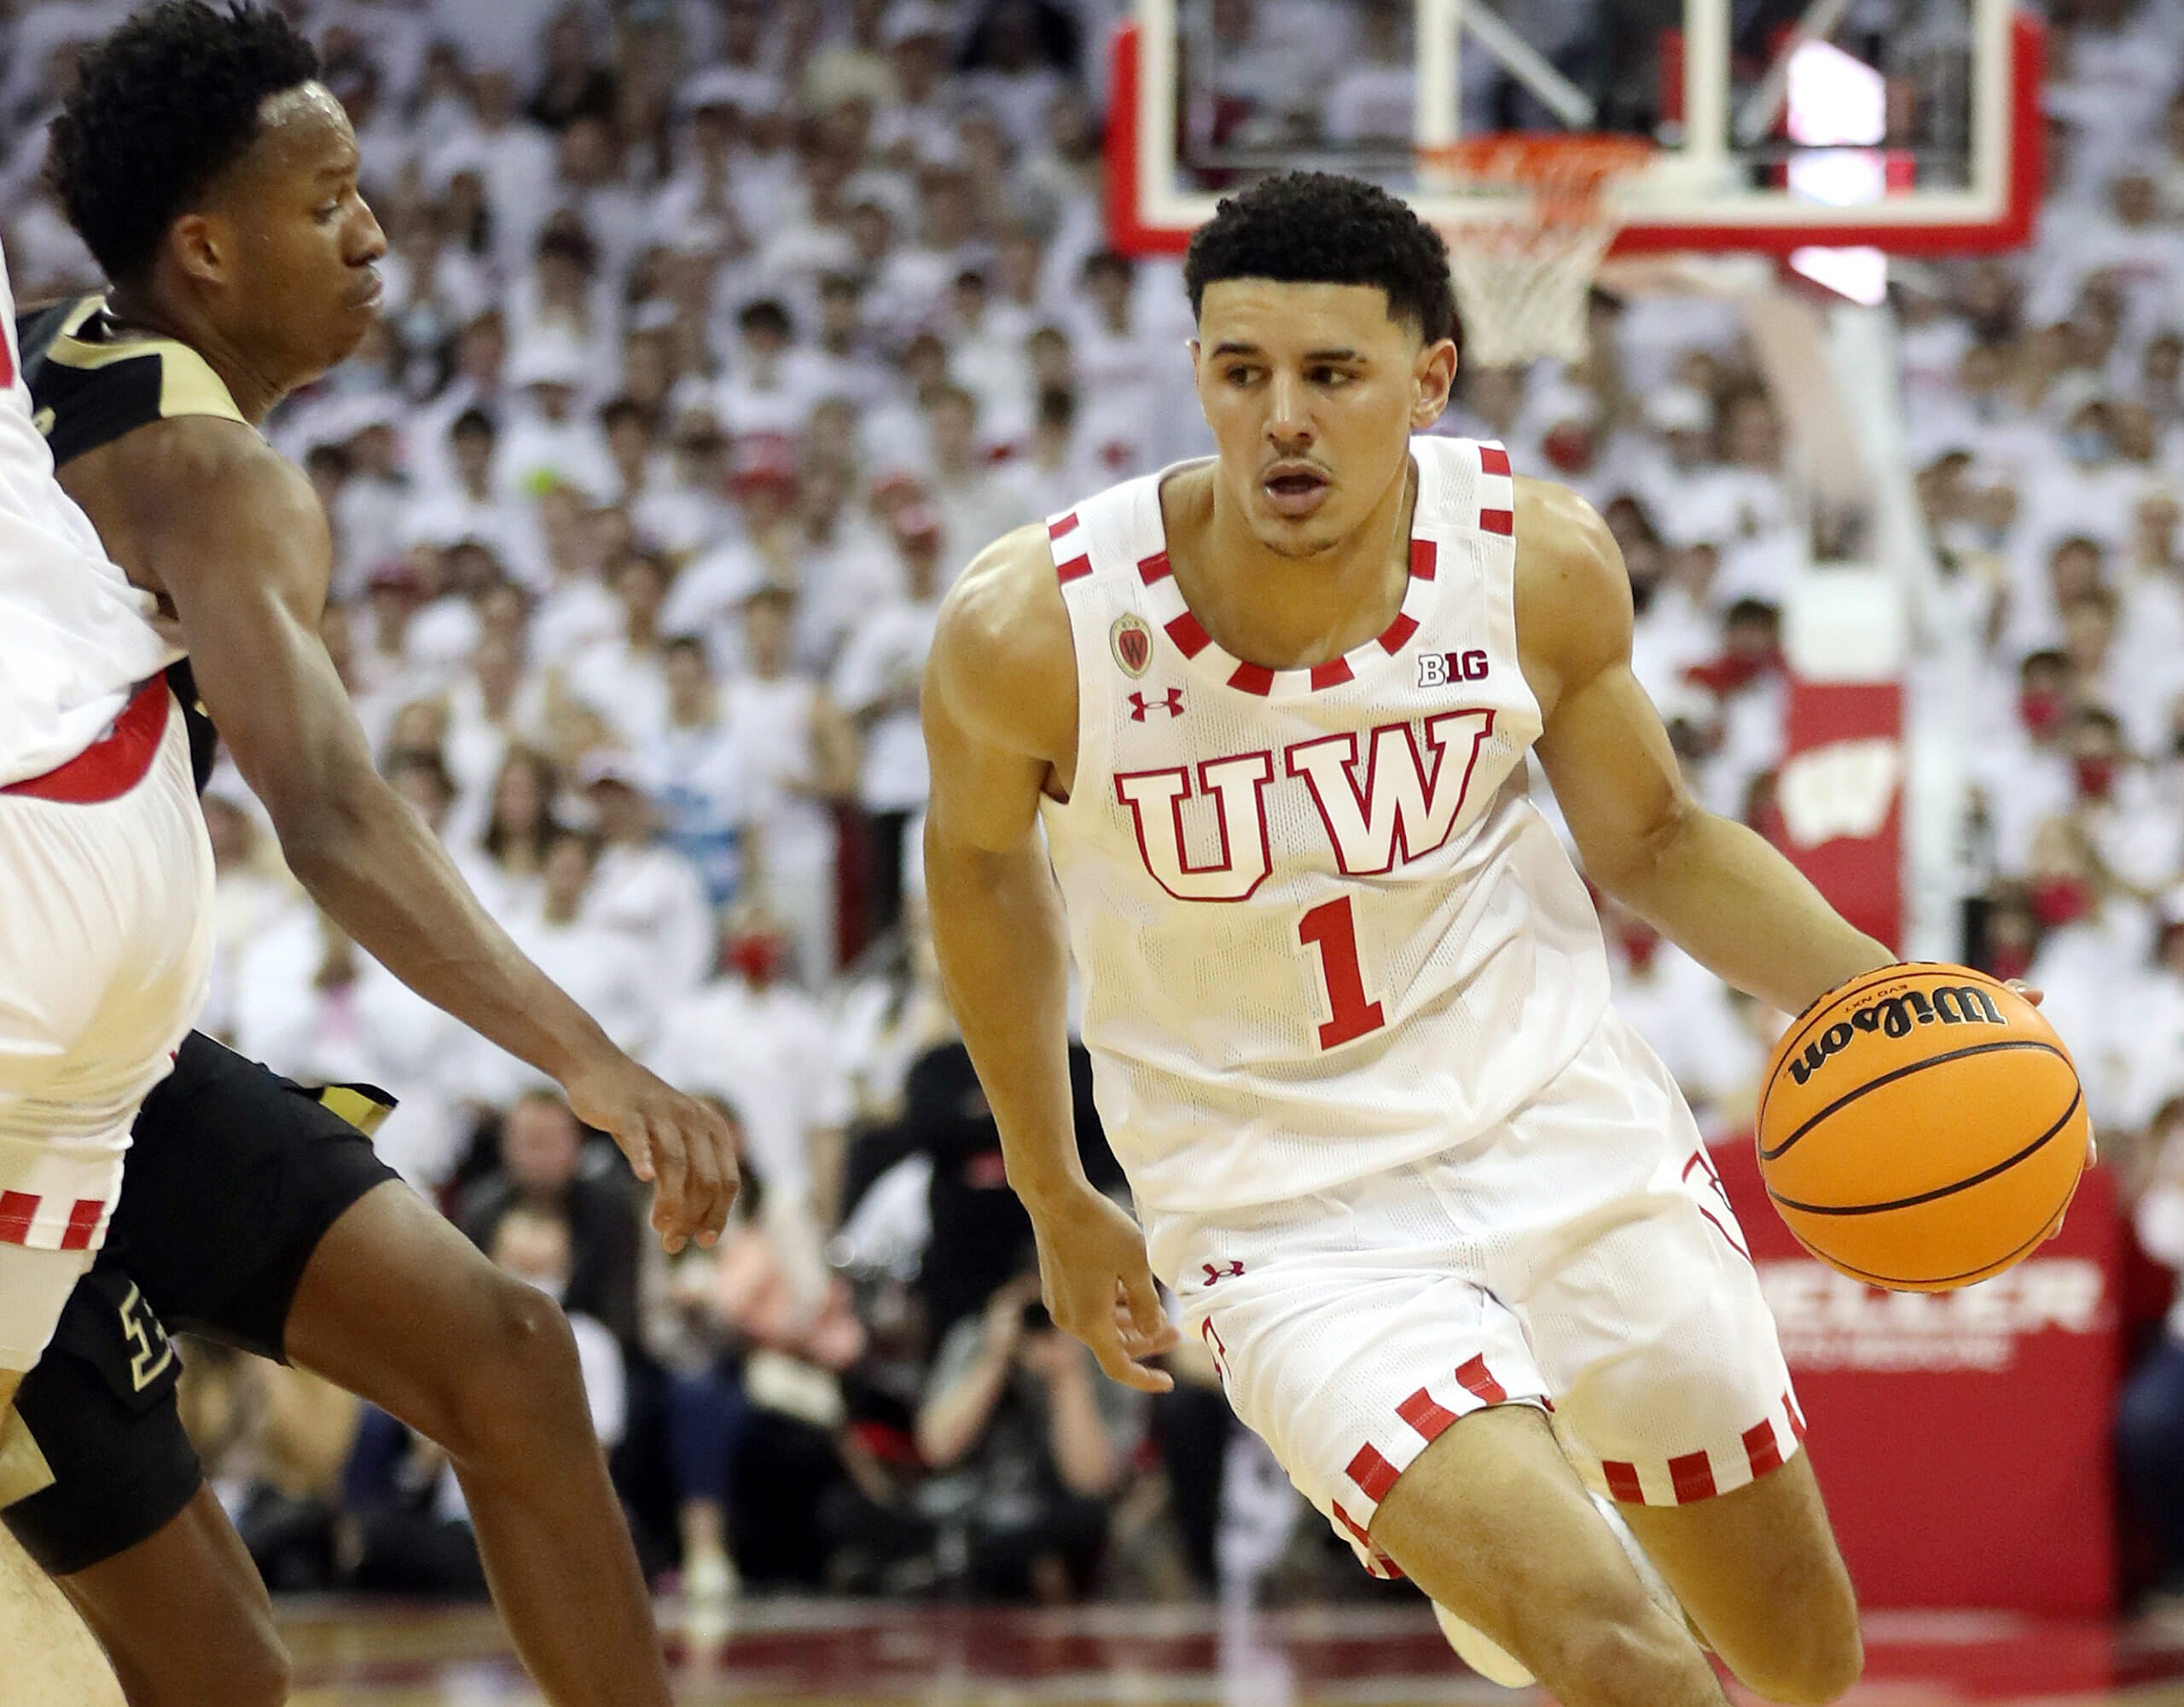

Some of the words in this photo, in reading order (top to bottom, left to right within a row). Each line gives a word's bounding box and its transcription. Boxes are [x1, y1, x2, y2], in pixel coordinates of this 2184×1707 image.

[1112, 708, 1497, 903] UW
[1298, 895, 1386, 1052] 1
[1787, 986, 2007, 1086] Wilson
